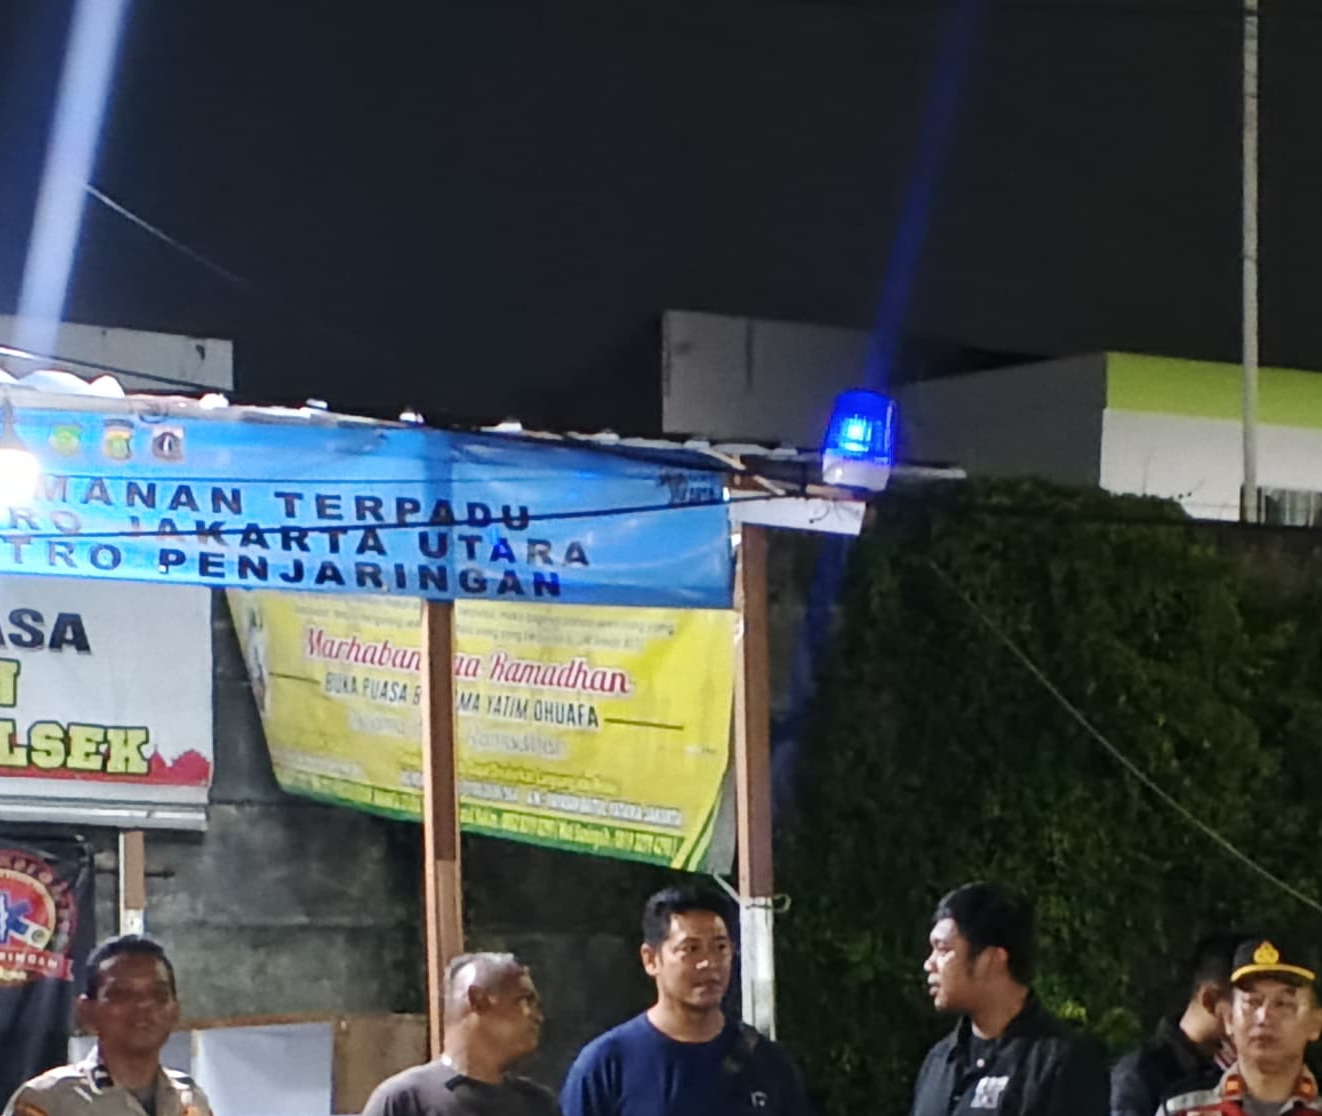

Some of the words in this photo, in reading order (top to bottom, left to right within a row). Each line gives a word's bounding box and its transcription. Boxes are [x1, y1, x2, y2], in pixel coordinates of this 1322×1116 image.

[275, 491, 530, 532] TERPADU
[129, 515, 388, 557] JAKARTA
[418, 531, 590, 568] UTARA
[158, 548, 562, 598] PENJARINGAN
[308, 627, 422, 672] Marhaban
[490, 652, 630, 694] Ramadhan
[324, 671, 358, 695] BUKA
[362, 679, 408, 704] PUASA
[486, 694, 528, 721] YATIM
